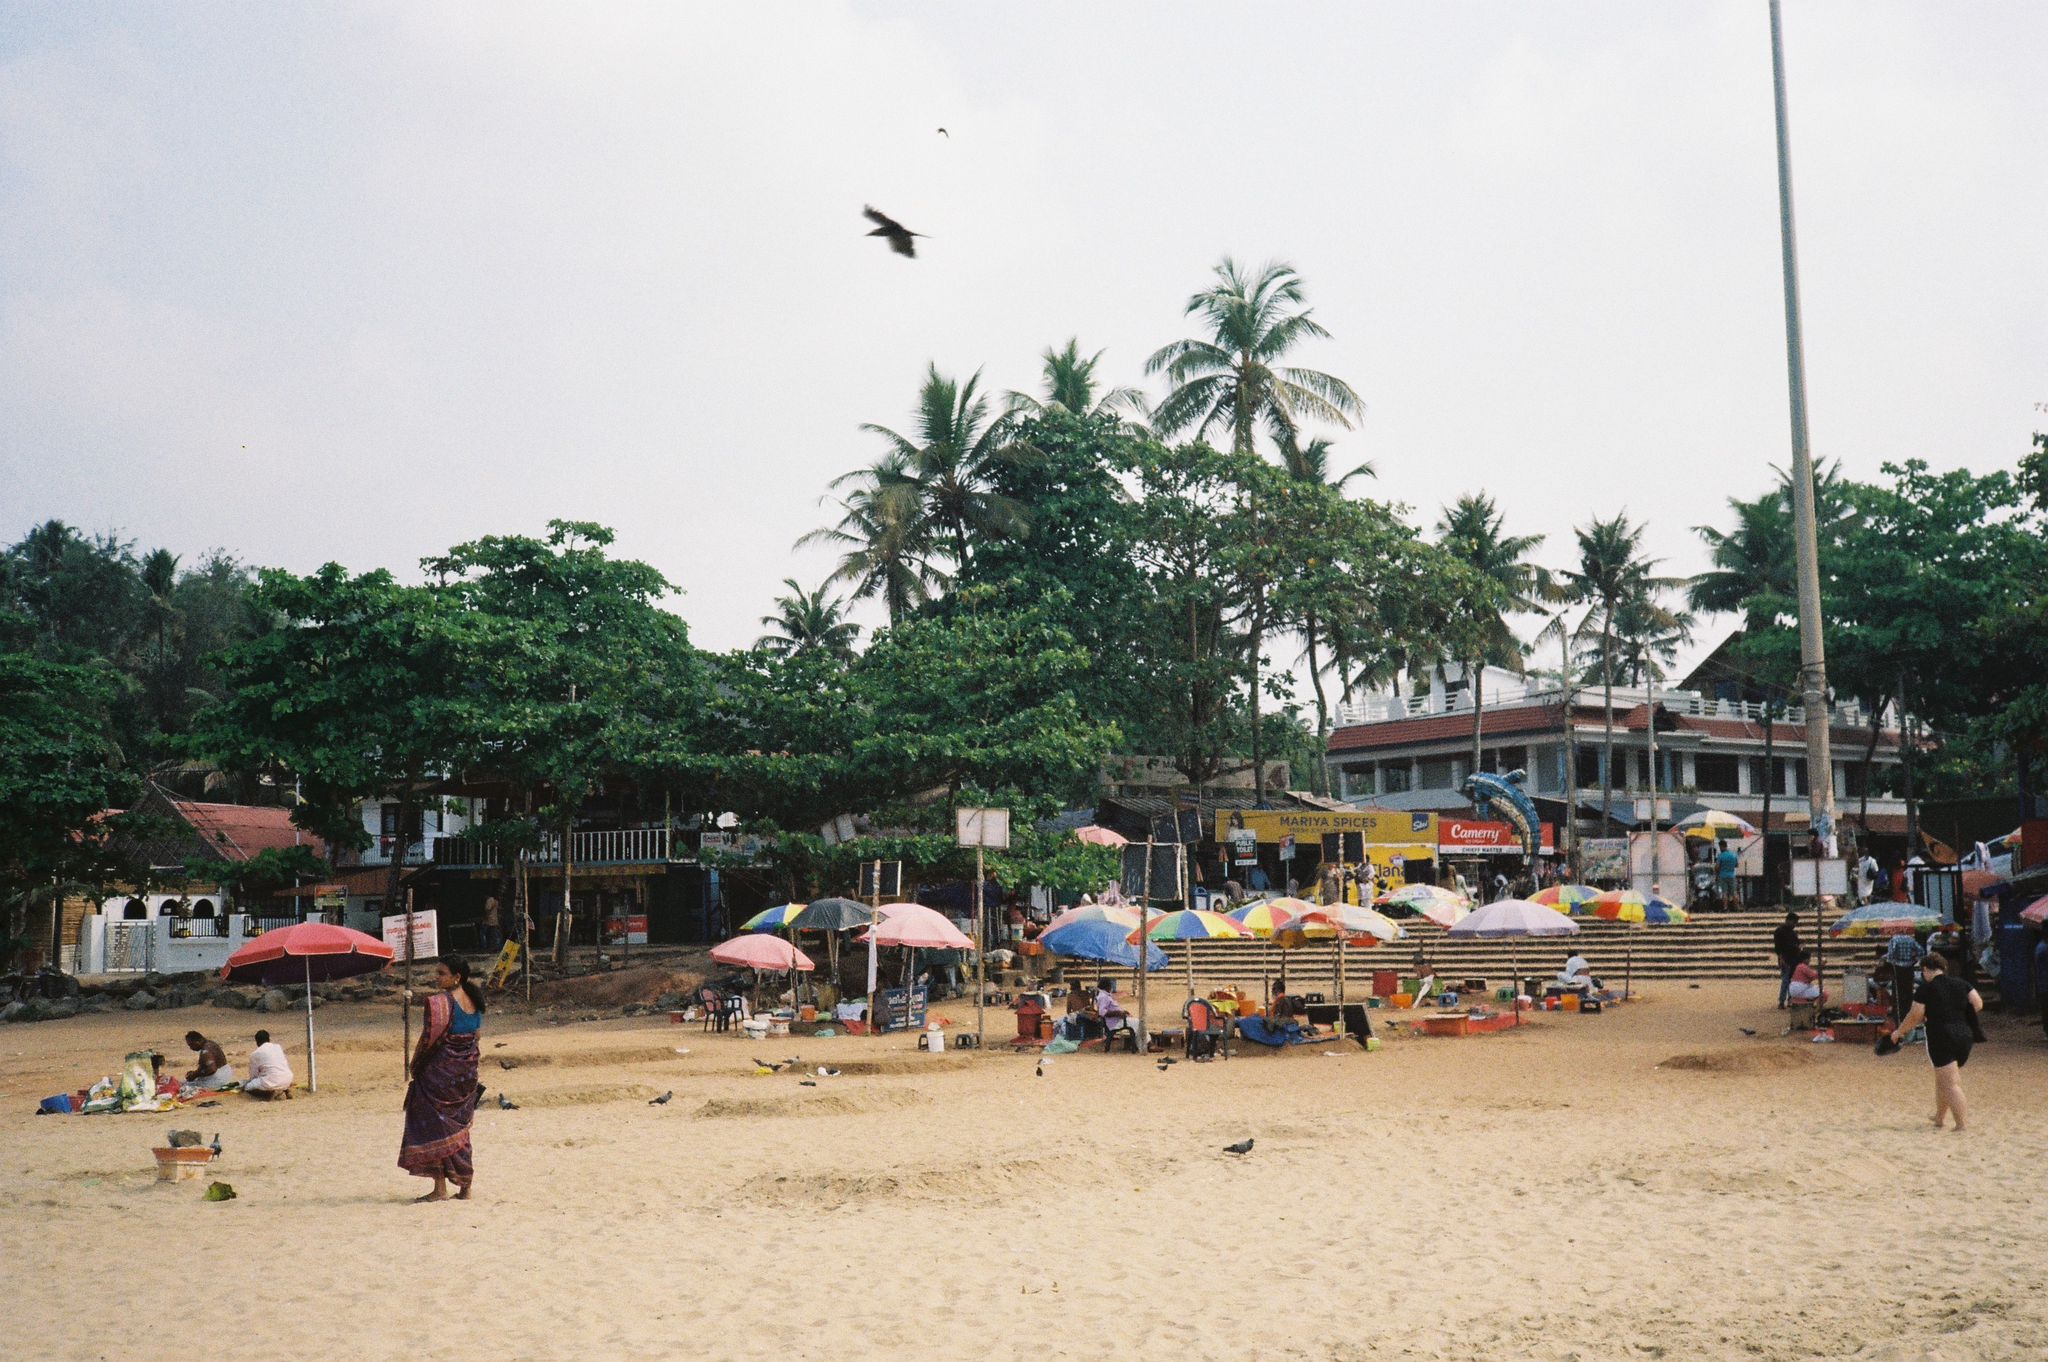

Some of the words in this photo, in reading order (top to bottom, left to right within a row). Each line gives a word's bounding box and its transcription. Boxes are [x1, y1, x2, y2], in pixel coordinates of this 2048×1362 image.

[1279, 816, 1329, 827] MARIYA
[1333, 817, 1377, 828] SPICES
[1451, 824, 1500, 843] Camerry
